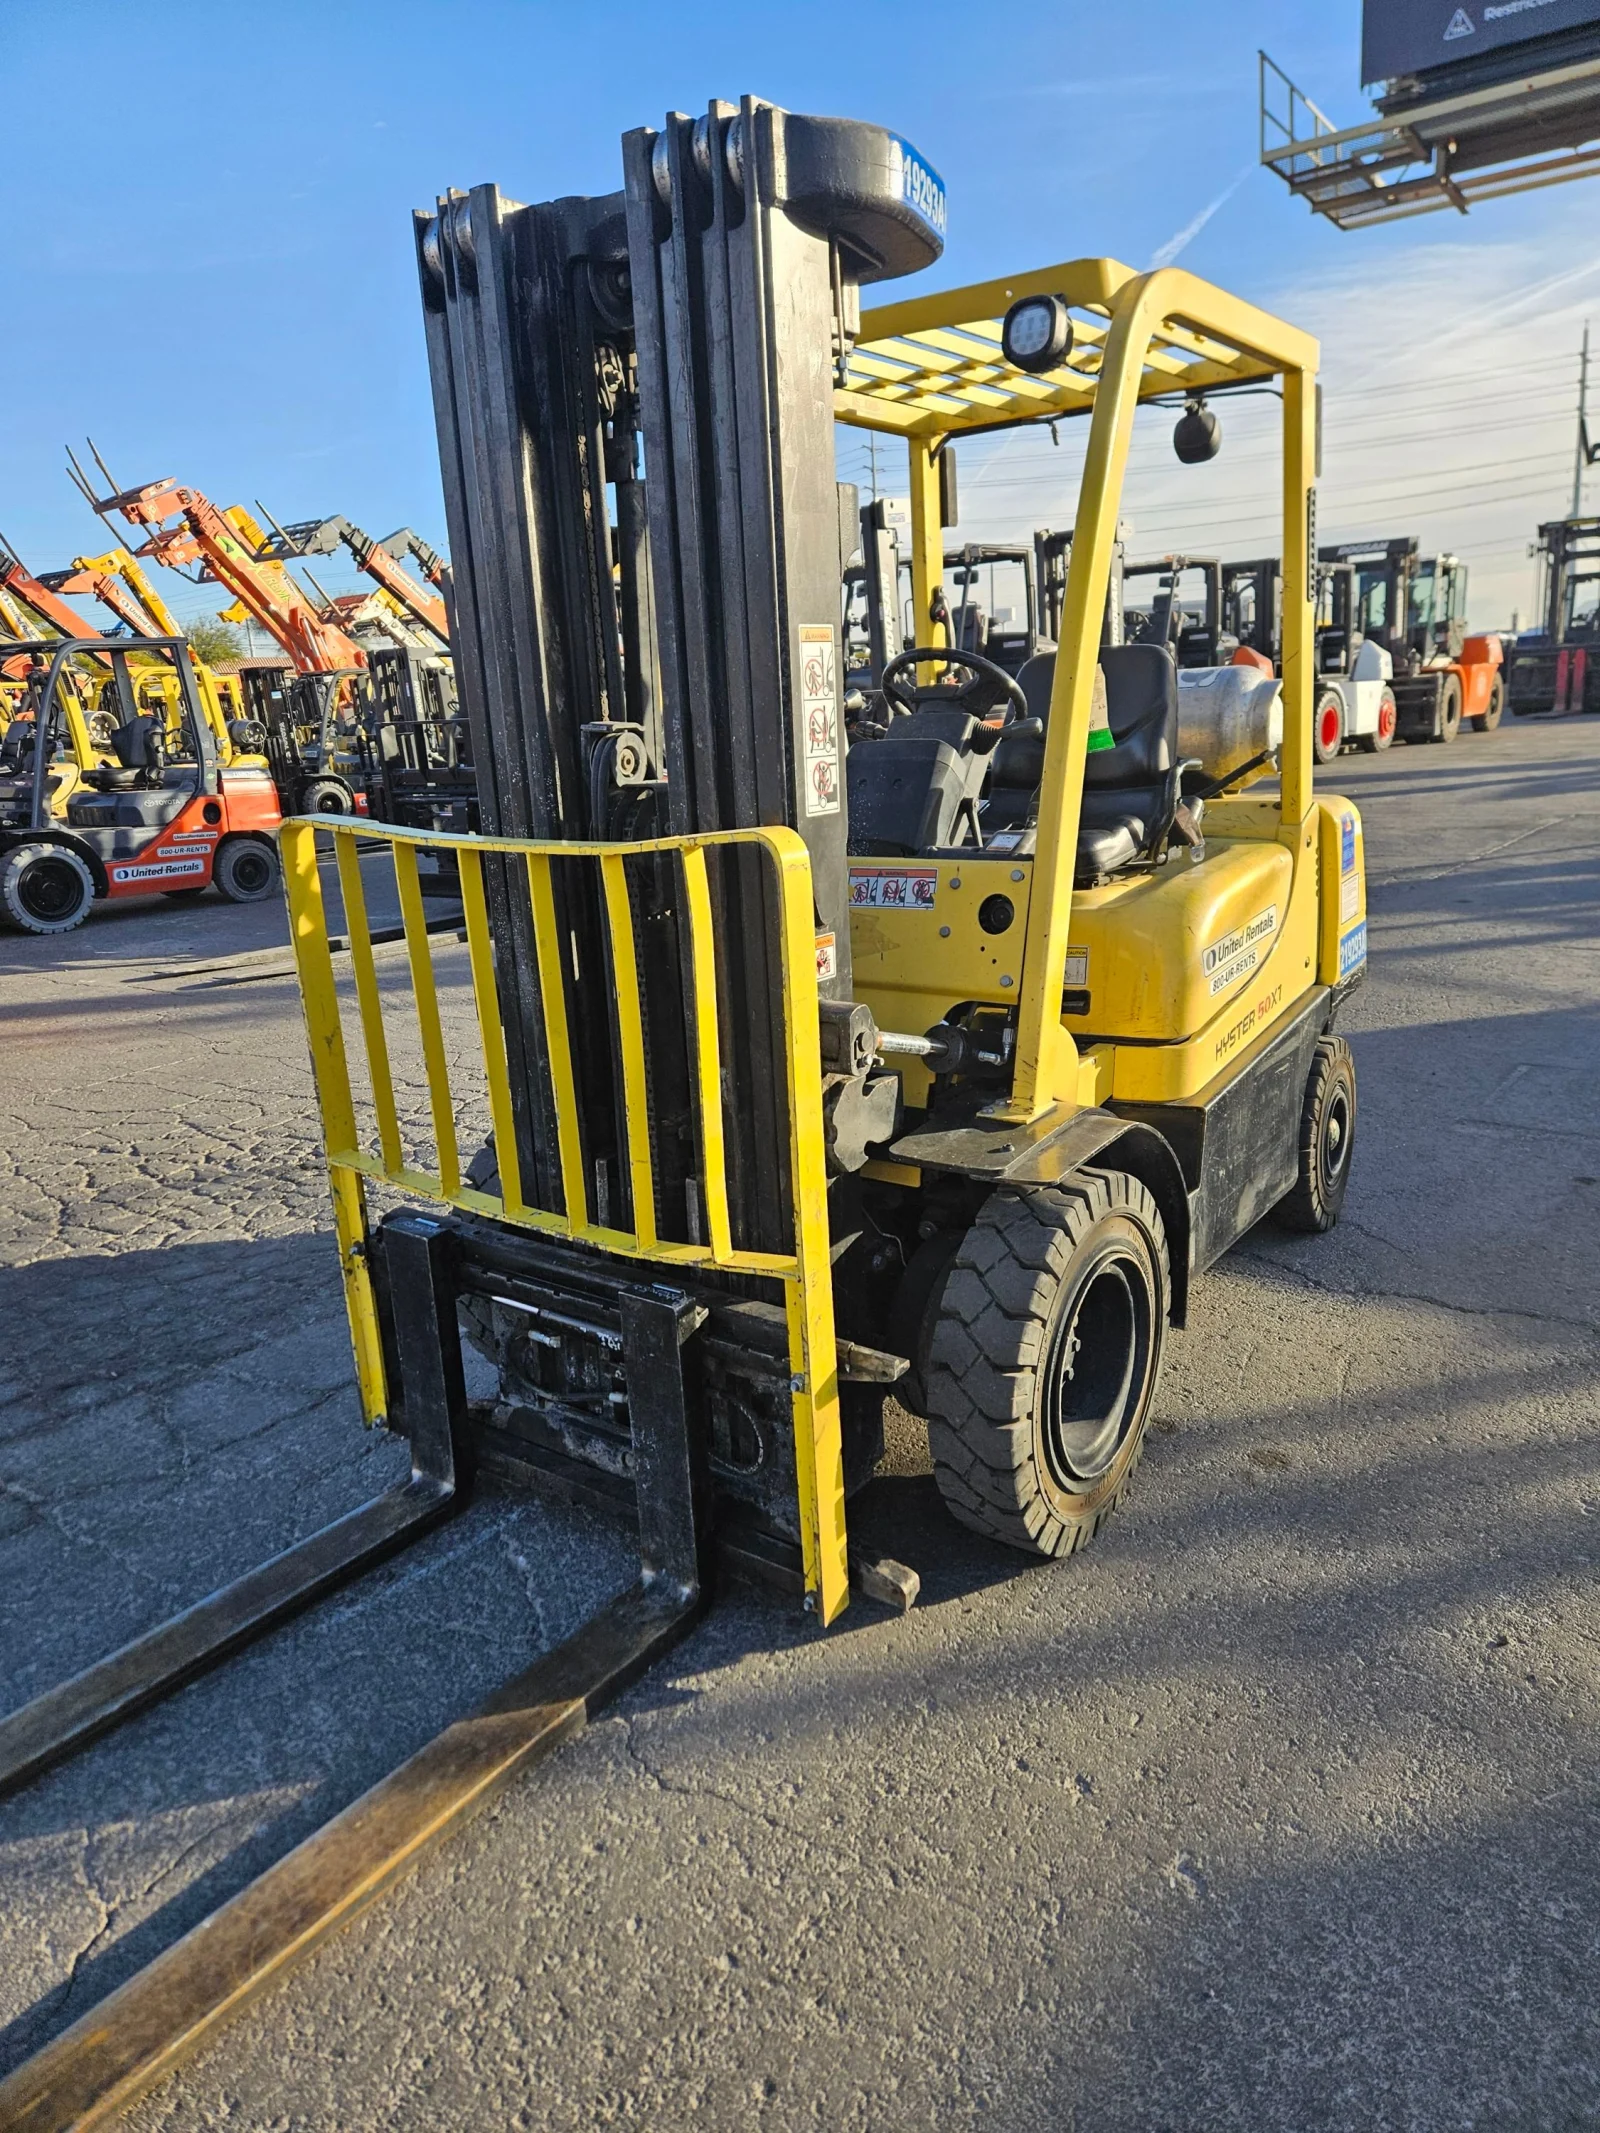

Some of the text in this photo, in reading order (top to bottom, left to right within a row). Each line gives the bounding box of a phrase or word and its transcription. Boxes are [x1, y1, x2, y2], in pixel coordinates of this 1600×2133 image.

[881, 571, 895, 658] DOOSAN
[131, 862, 200, 878] United Rentals
[160, 846, 208, 855] 800-UR-RENTS
[1217, 913, 1274, 963] United Rentals
[1212, 951, 1256, 992] 800-UR-RENTS
[1215, 984, 1283, 1062] HYSTER 50XT
